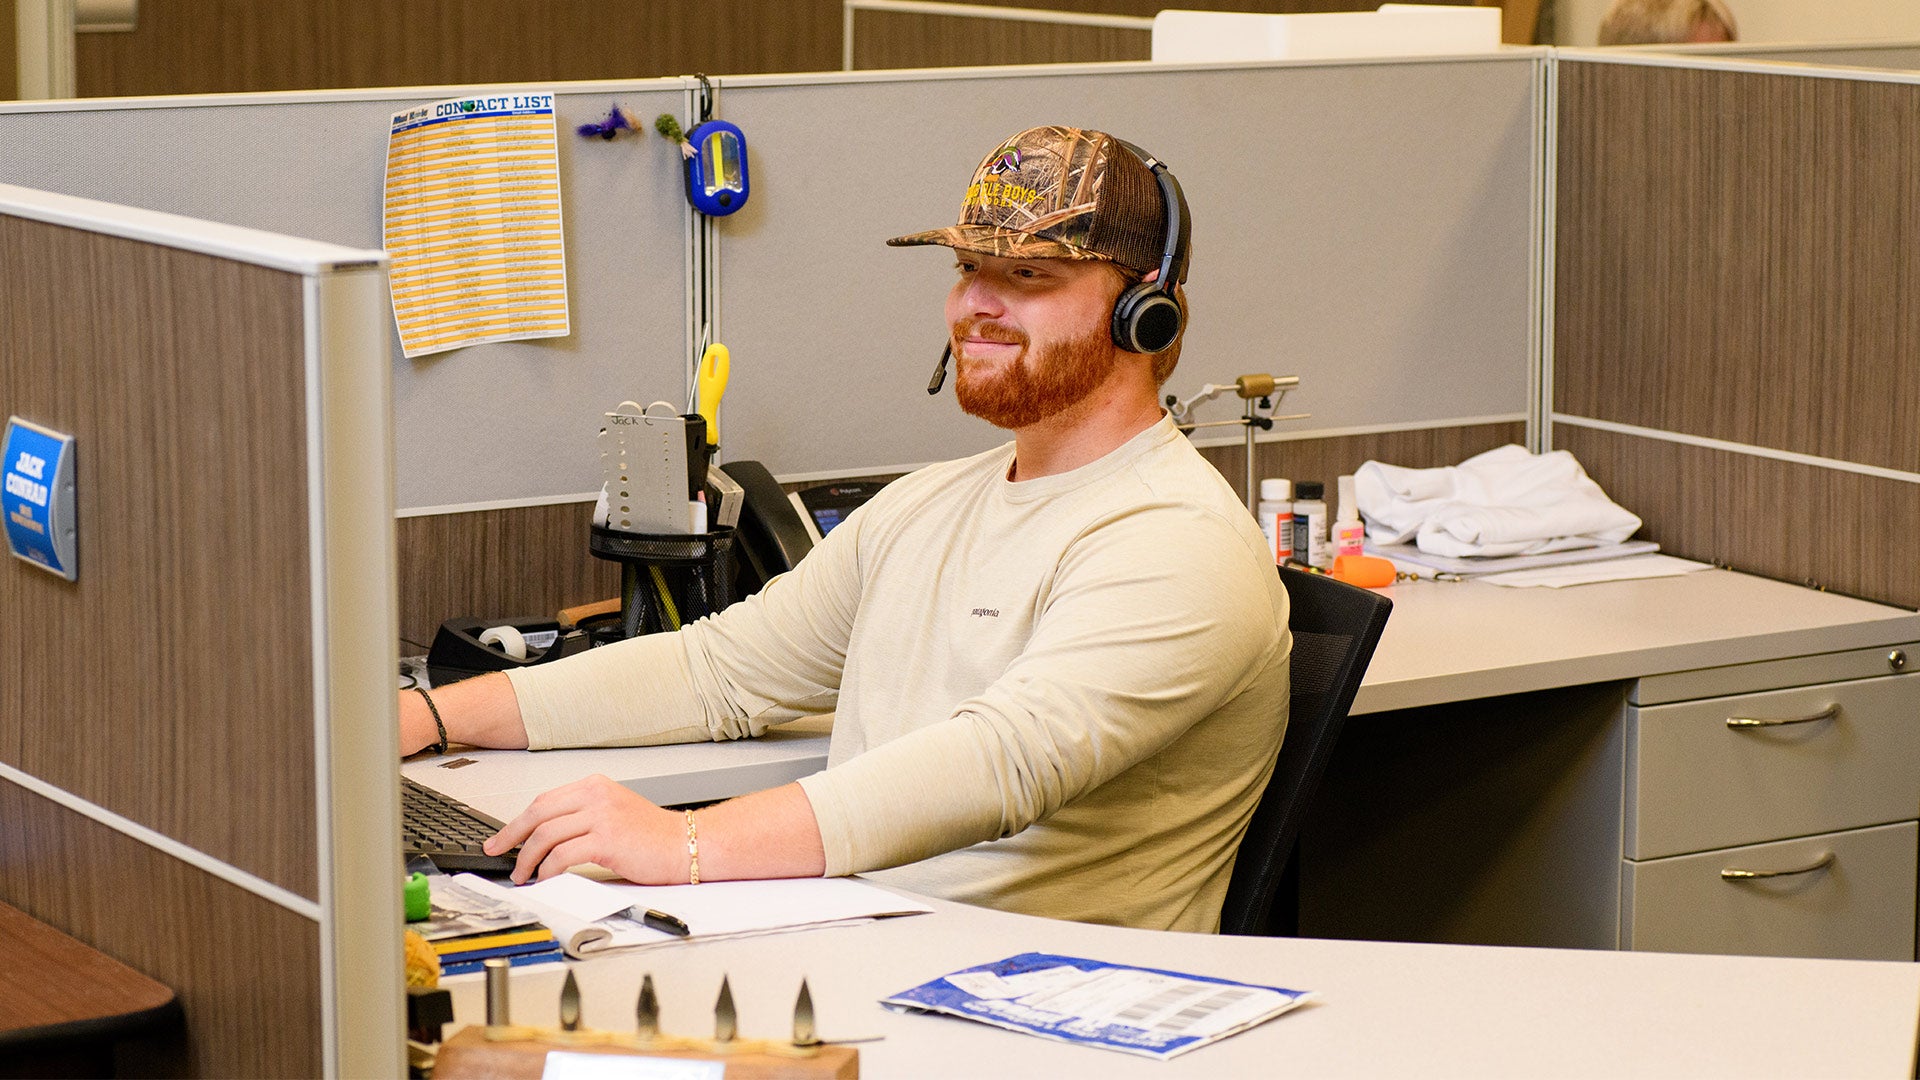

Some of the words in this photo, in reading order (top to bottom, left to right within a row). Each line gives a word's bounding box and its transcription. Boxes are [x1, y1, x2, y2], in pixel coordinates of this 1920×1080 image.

[436, 97, 508, 117] CONACT
[513, 96, 552, 109] LIST
[1002, 184, 1037, 204] BOYS
[611, 415, 639, 426] Jack
[645, 417, 654, 426] C
